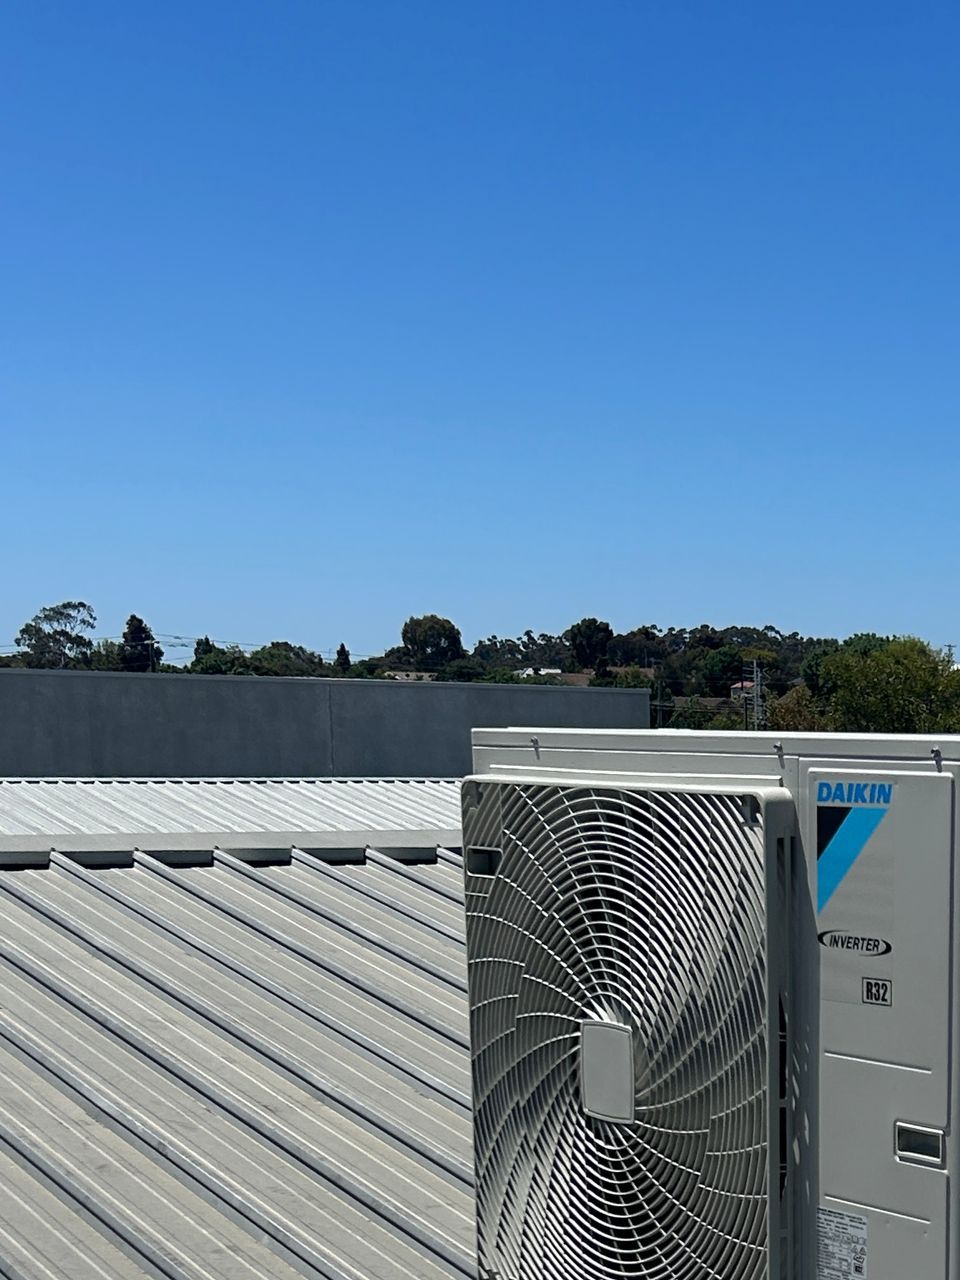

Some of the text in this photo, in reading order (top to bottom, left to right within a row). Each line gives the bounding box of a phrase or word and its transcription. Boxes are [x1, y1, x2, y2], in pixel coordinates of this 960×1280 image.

[817, 782, 893, 804] DAIKIN
[829, 934, 881, 952] INVERTER
[866, 981, 888, 1003] R32
